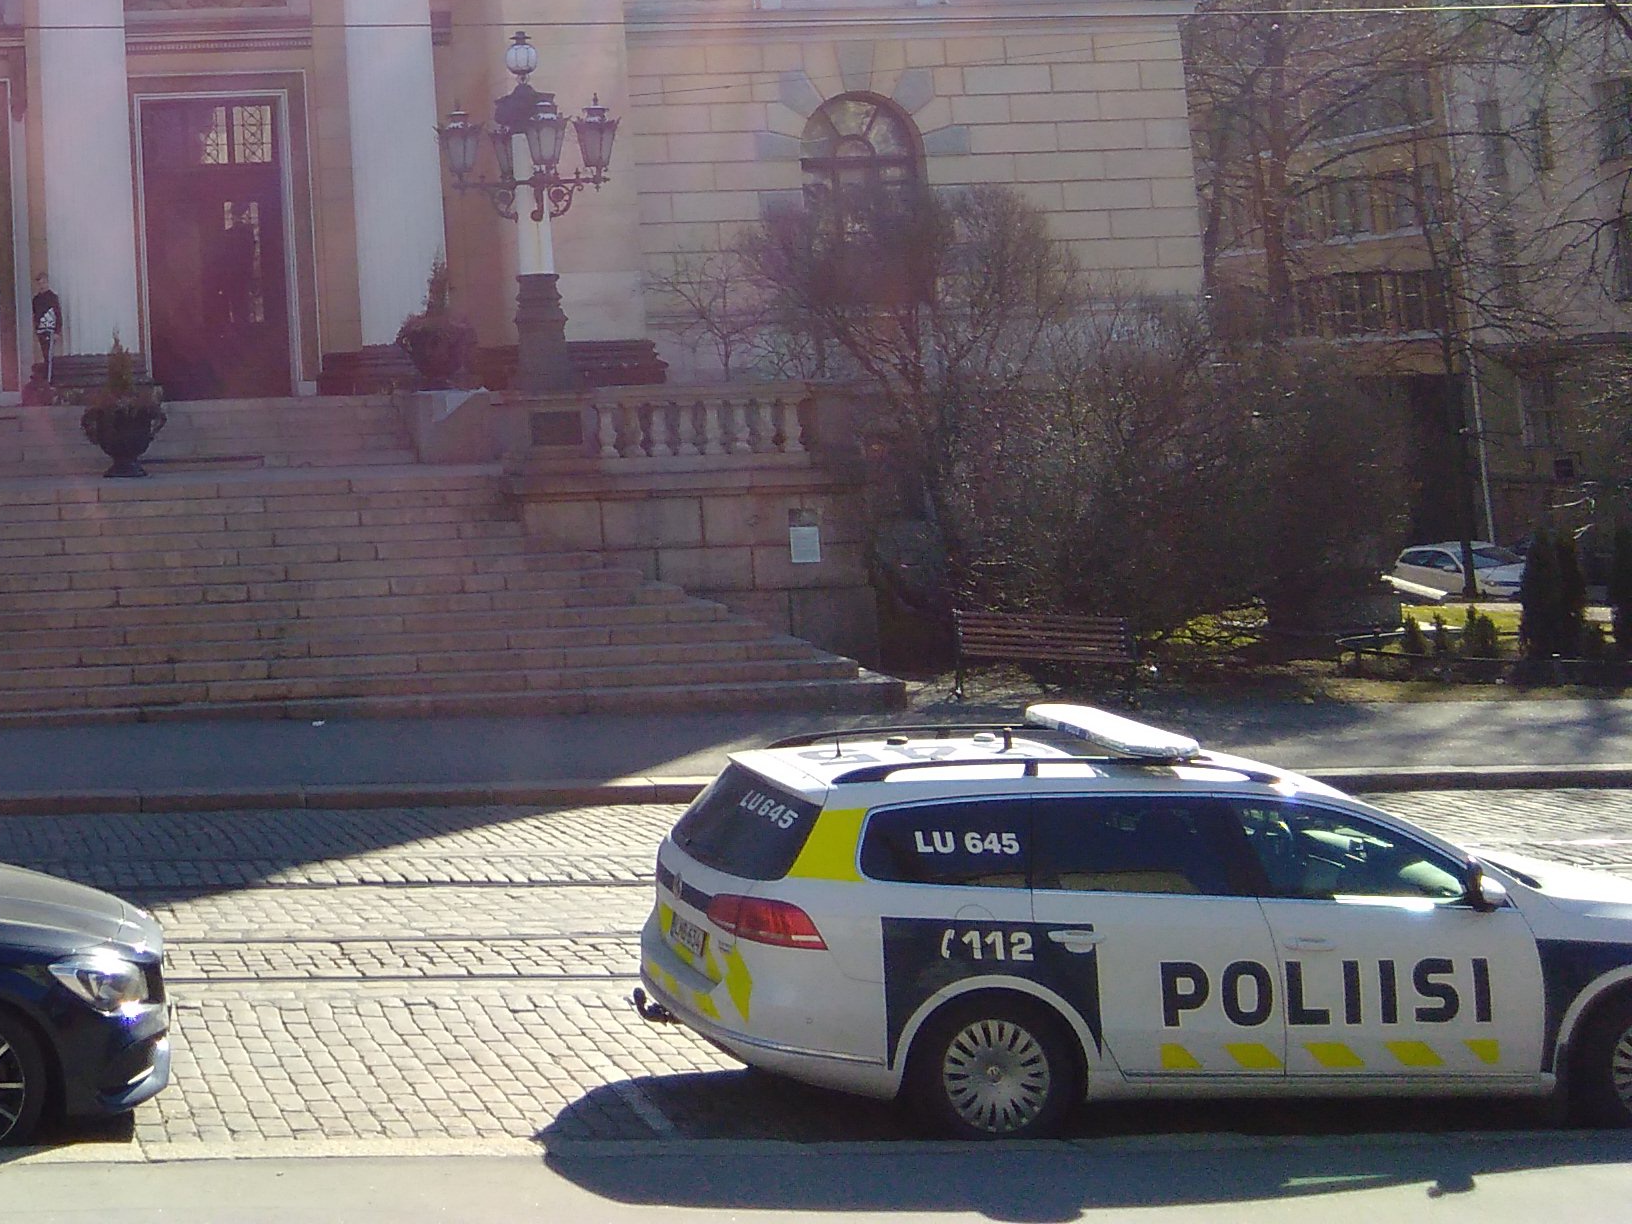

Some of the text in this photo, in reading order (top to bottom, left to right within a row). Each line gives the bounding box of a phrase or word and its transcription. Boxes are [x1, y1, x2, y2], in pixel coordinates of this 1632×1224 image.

[915, 831, 1020, 855] LU 645
[962, 930, 1034, 962] 112
[1159, 957, 1493, 1027] POLIISI
